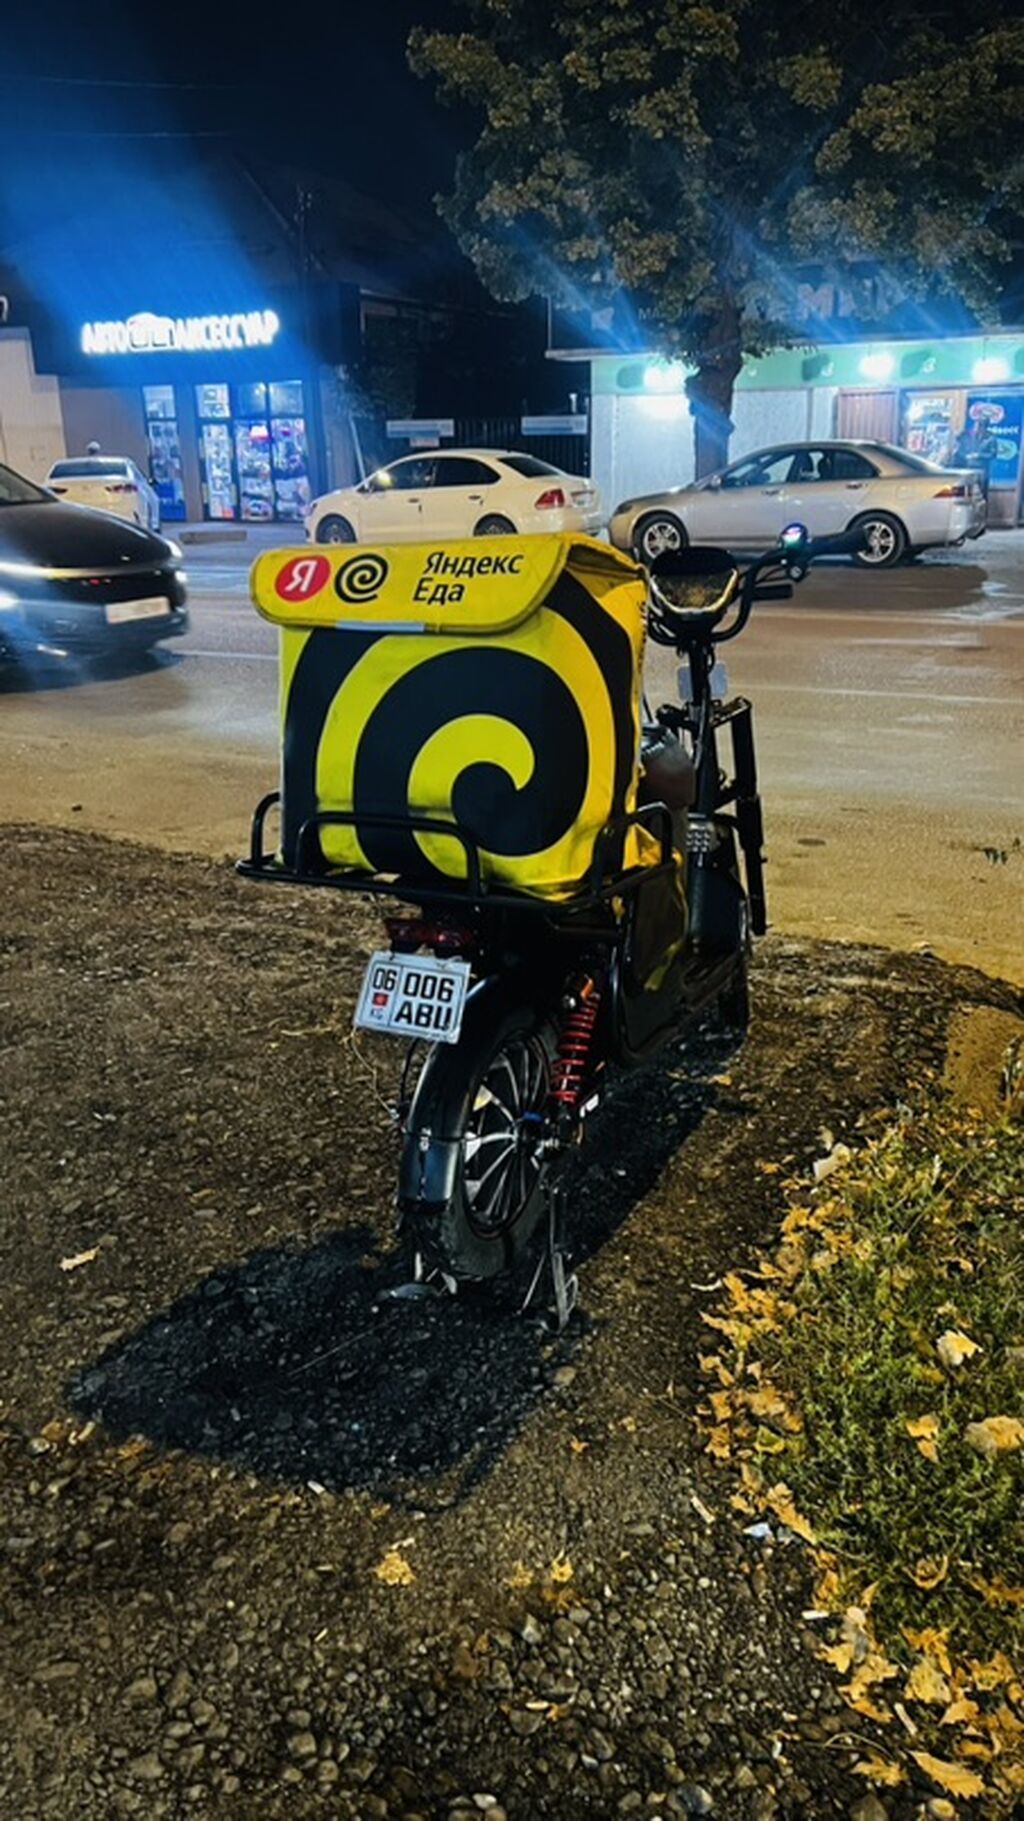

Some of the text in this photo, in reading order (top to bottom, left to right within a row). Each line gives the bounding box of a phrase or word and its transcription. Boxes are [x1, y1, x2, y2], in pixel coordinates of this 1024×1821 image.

[422, 551, 525, 579] Яндекс
[412, 576, 466, 607] Еда
[372, 968, 455, 1004] 06 006
